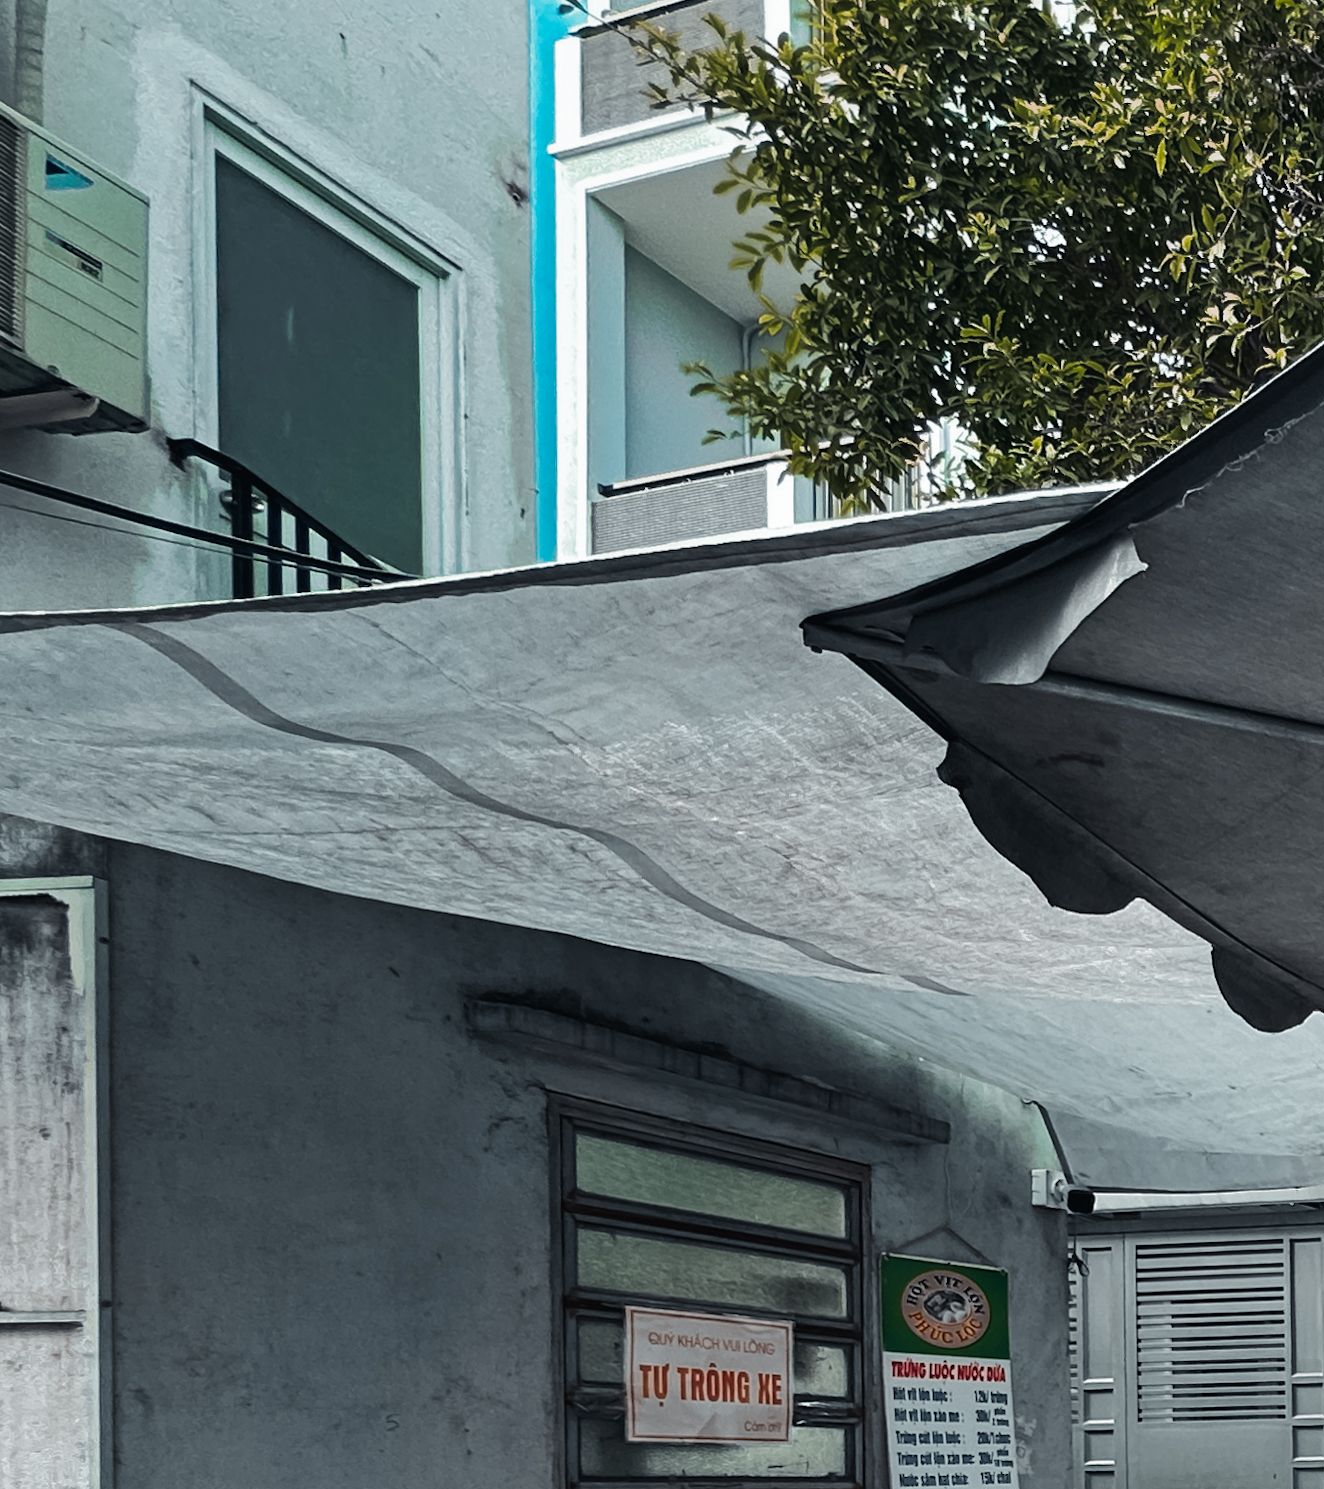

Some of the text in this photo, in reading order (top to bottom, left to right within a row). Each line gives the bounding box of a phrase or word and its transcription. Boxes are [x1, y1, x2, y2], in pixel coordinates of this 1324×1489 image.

[678, 1334, 720, 1351] KHÁCH
[891, 1357, 927, 1378] TRỨNG
[929, 1360, 955, 1384] LUỘC
[639, 1362, 782, 1407] TỰ TRÔNG XE
